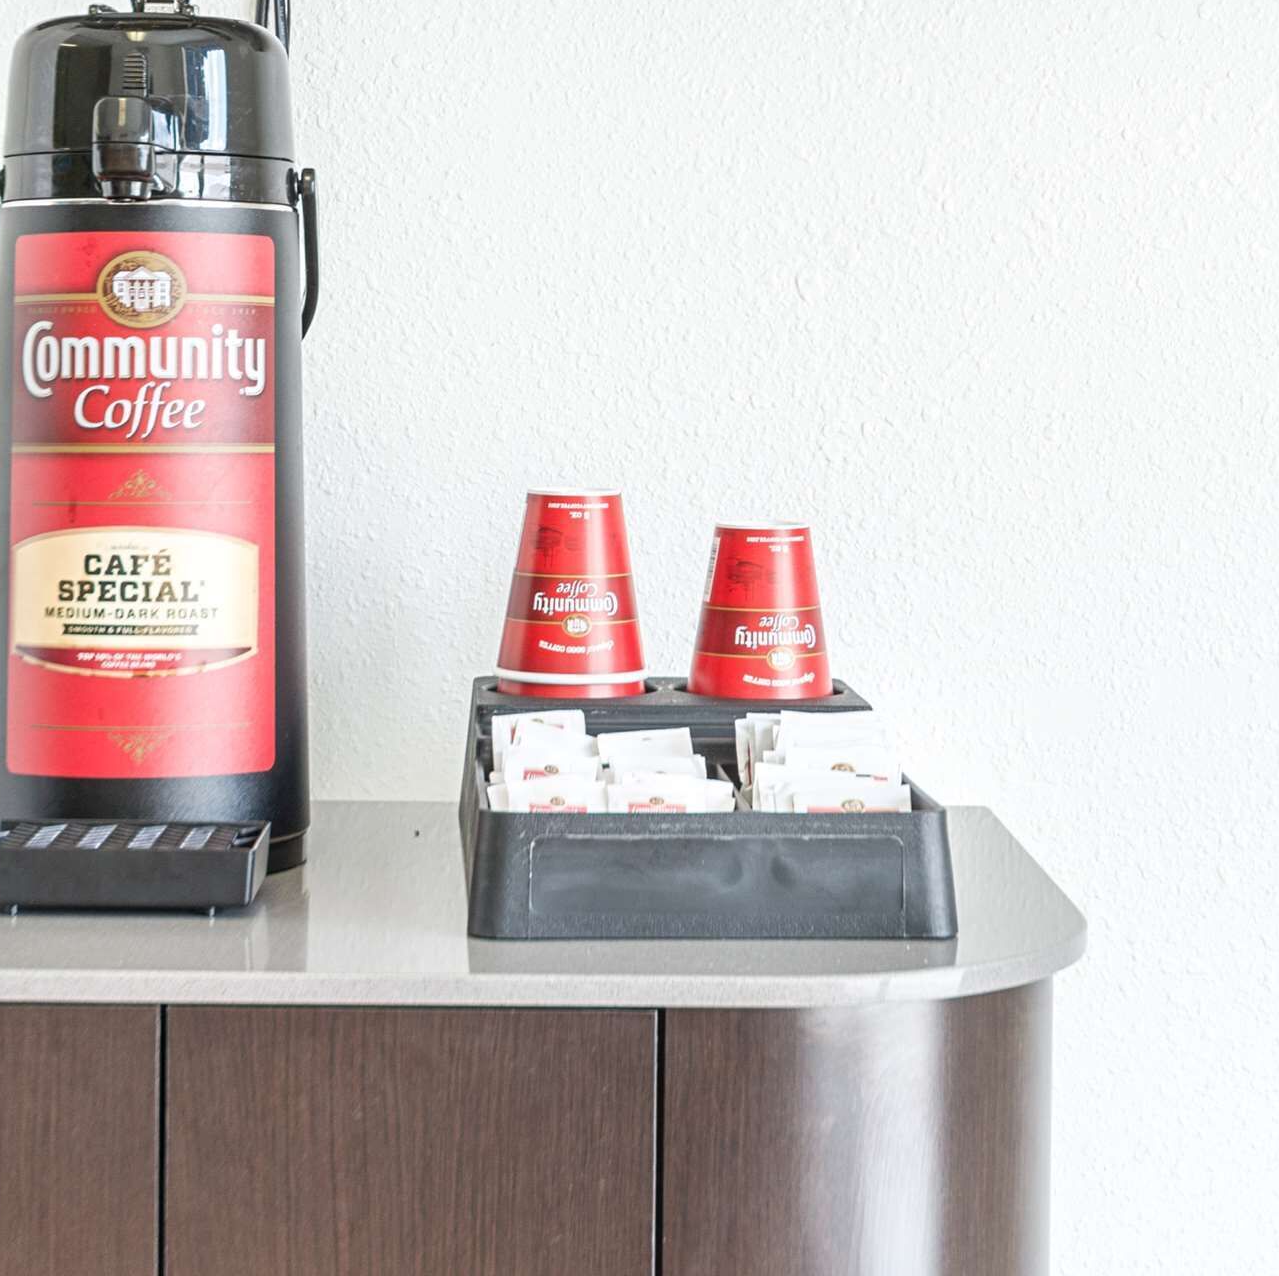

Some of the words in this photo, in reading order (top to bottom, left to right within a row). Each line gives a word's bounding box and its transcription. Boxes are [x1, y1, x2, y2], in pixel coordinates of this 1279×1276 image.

[22, 320, 266, 399] Community
[73, 381, 206, 439] Coffee
[84, 549, 172, 576] CAFÉ
[58, 580, 199, 602] SPECIAL
[555, 580, 598, 598] Coffee
[44, 607, 160, 620] MEDIUM-DARK
[166, 607, 219, 620] ROAST
[533, 591, 618, 616] Community
[758, 613, 800, 631] Coffee
[734, 623, 816, 649] Community
